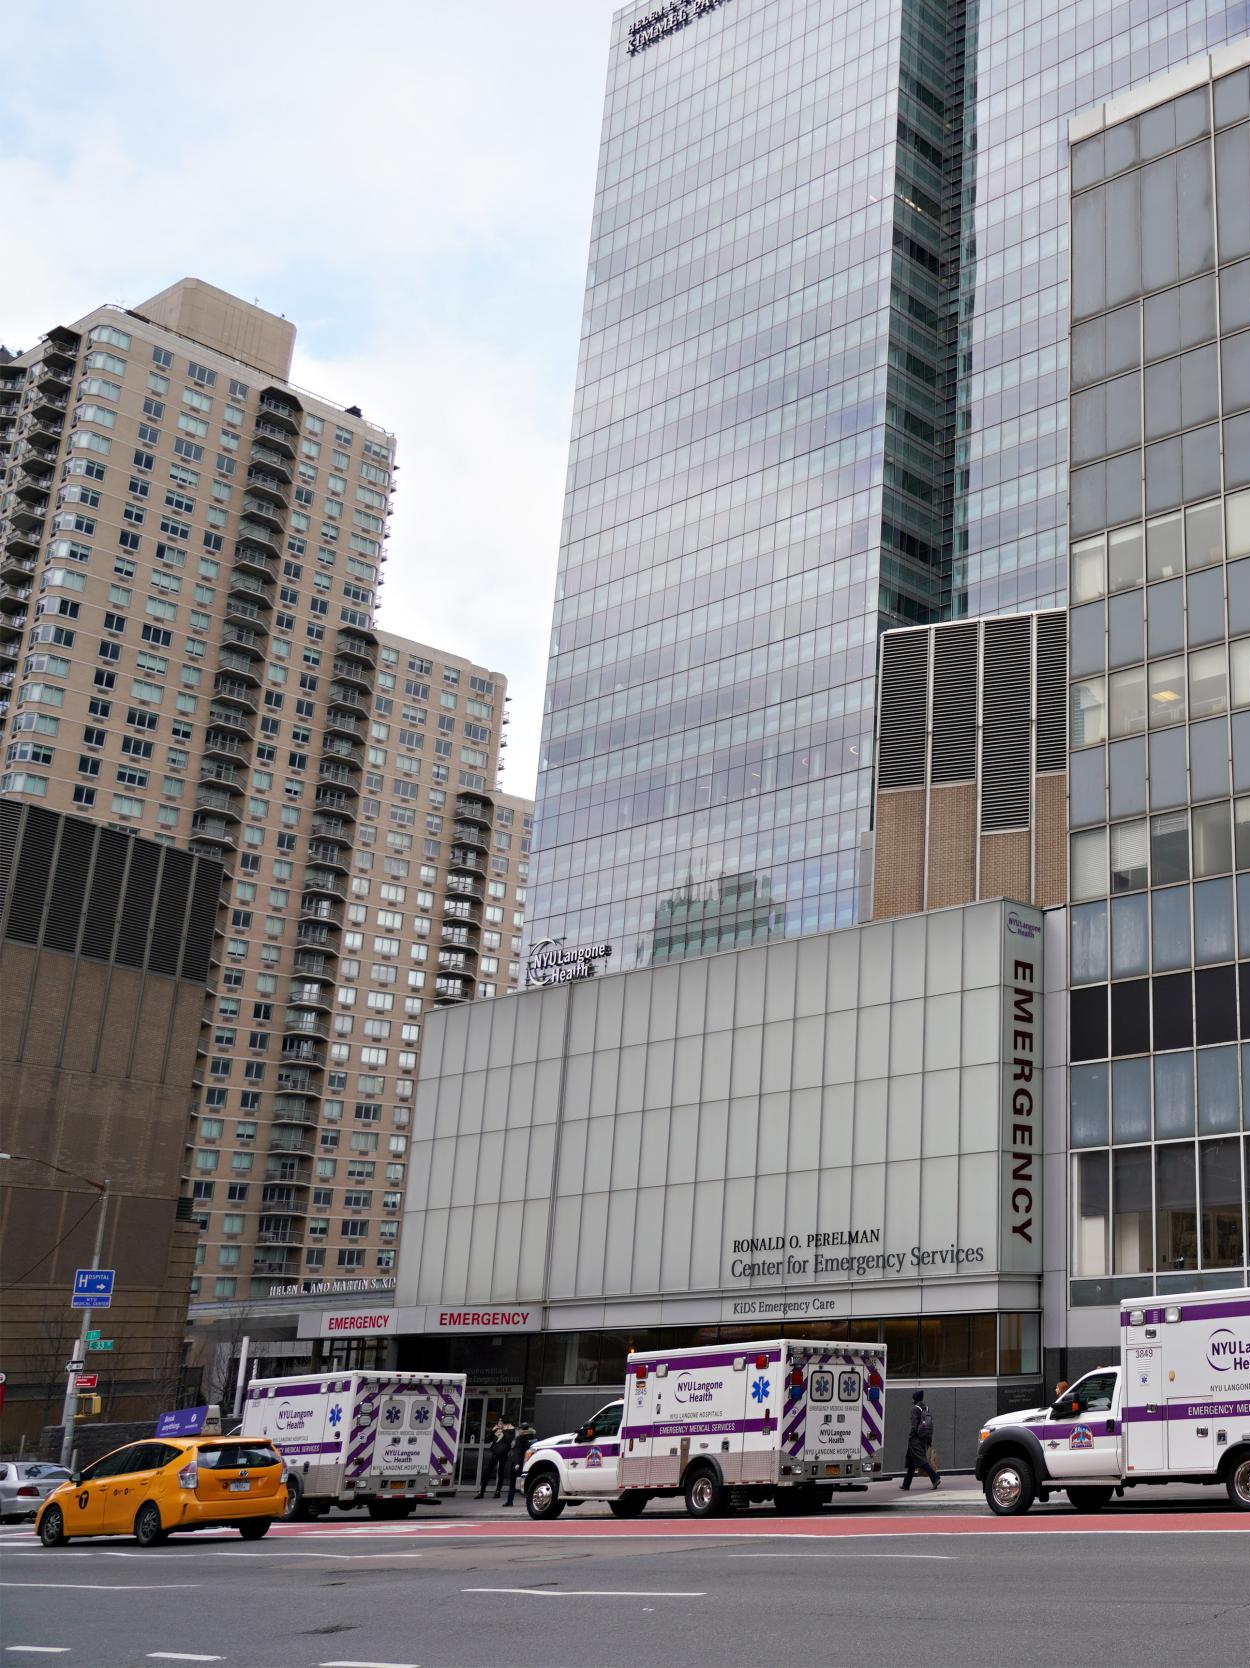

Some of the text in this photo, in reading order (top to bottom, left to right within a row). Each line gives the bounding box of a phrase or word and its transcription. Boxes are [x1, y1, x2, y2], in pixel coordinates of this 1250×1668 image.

[627, 9, 688, 50] KIMMEL
[1008, 918, 1020, 927] NYU
[1017, 928, 1035, 939] Health
[534, 944, 606, 968] NYU Langone
[551, 962, 589, 983] Health
[1011, 959, 1035, 1244] EMERGENCY
[733, 1229, 881, 1253] RONALD O. PERELMAN
[731, 1244, 984, 1278] Center for Emergency Services
[269, 1284, 298, 1297] HELEN
[310, 1282, 331, 1293] AND
[332, 1279, 369, 1292] MARTIN
[733, 1298, 836, 1315] KiDS Emergency Care
[328, 1315, 390, 1330] EMERGENCY
[439, 1312, 530, 1326] EMERGENCY
[1135, 1349, 1153, 1358] 3849
[1211, 1341, 1237, 1356] NYU
[677, 1380, 723, 1392] NYU Langone
[1210, 1384, 1223, 1393] NYU
[689, 1392, 713, 1403] Health
[279, 1409, 314, 1419] NYU Langone
[1187, 1404, 1234, 1416] EMERGENCY
[286, 1420, 305, 1430] Health
[659, 1422, 736, 1434] EMERGENCY MEDICAL SERVICES
[831, 1429, 852, 1437] Langone
[828, 1436, 845, 1444] Health
[284, 1446, 301, 1454] MEDICAL
[301, 1444, 320, 1453] SERVICES
[397, 1449, 421, 1457] Langone
